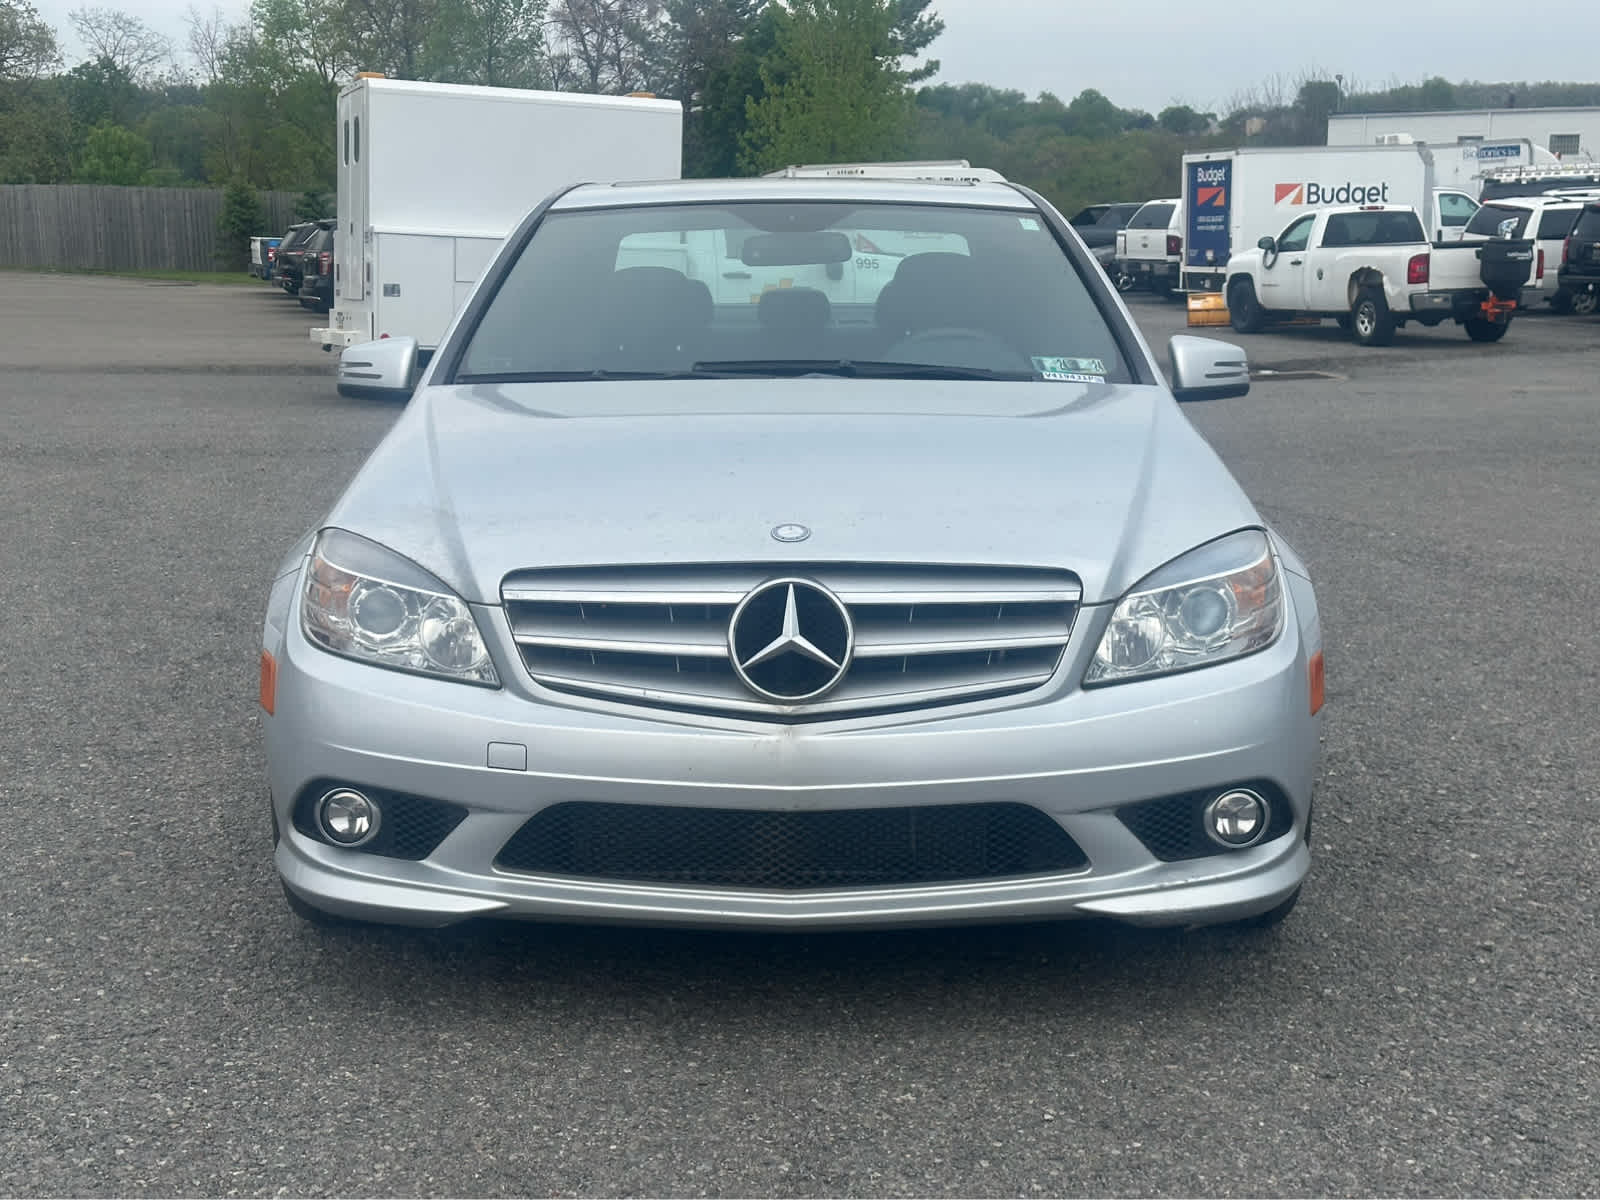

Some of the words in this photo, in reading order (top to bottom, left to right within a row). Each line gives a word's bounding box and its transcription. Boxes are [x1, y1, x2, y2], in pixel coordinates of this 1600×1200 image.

[1197, 166, 1225, 186] Budget
[1306, 181, 1389, 205] Budget
[856, 257, 880, 270] 995
